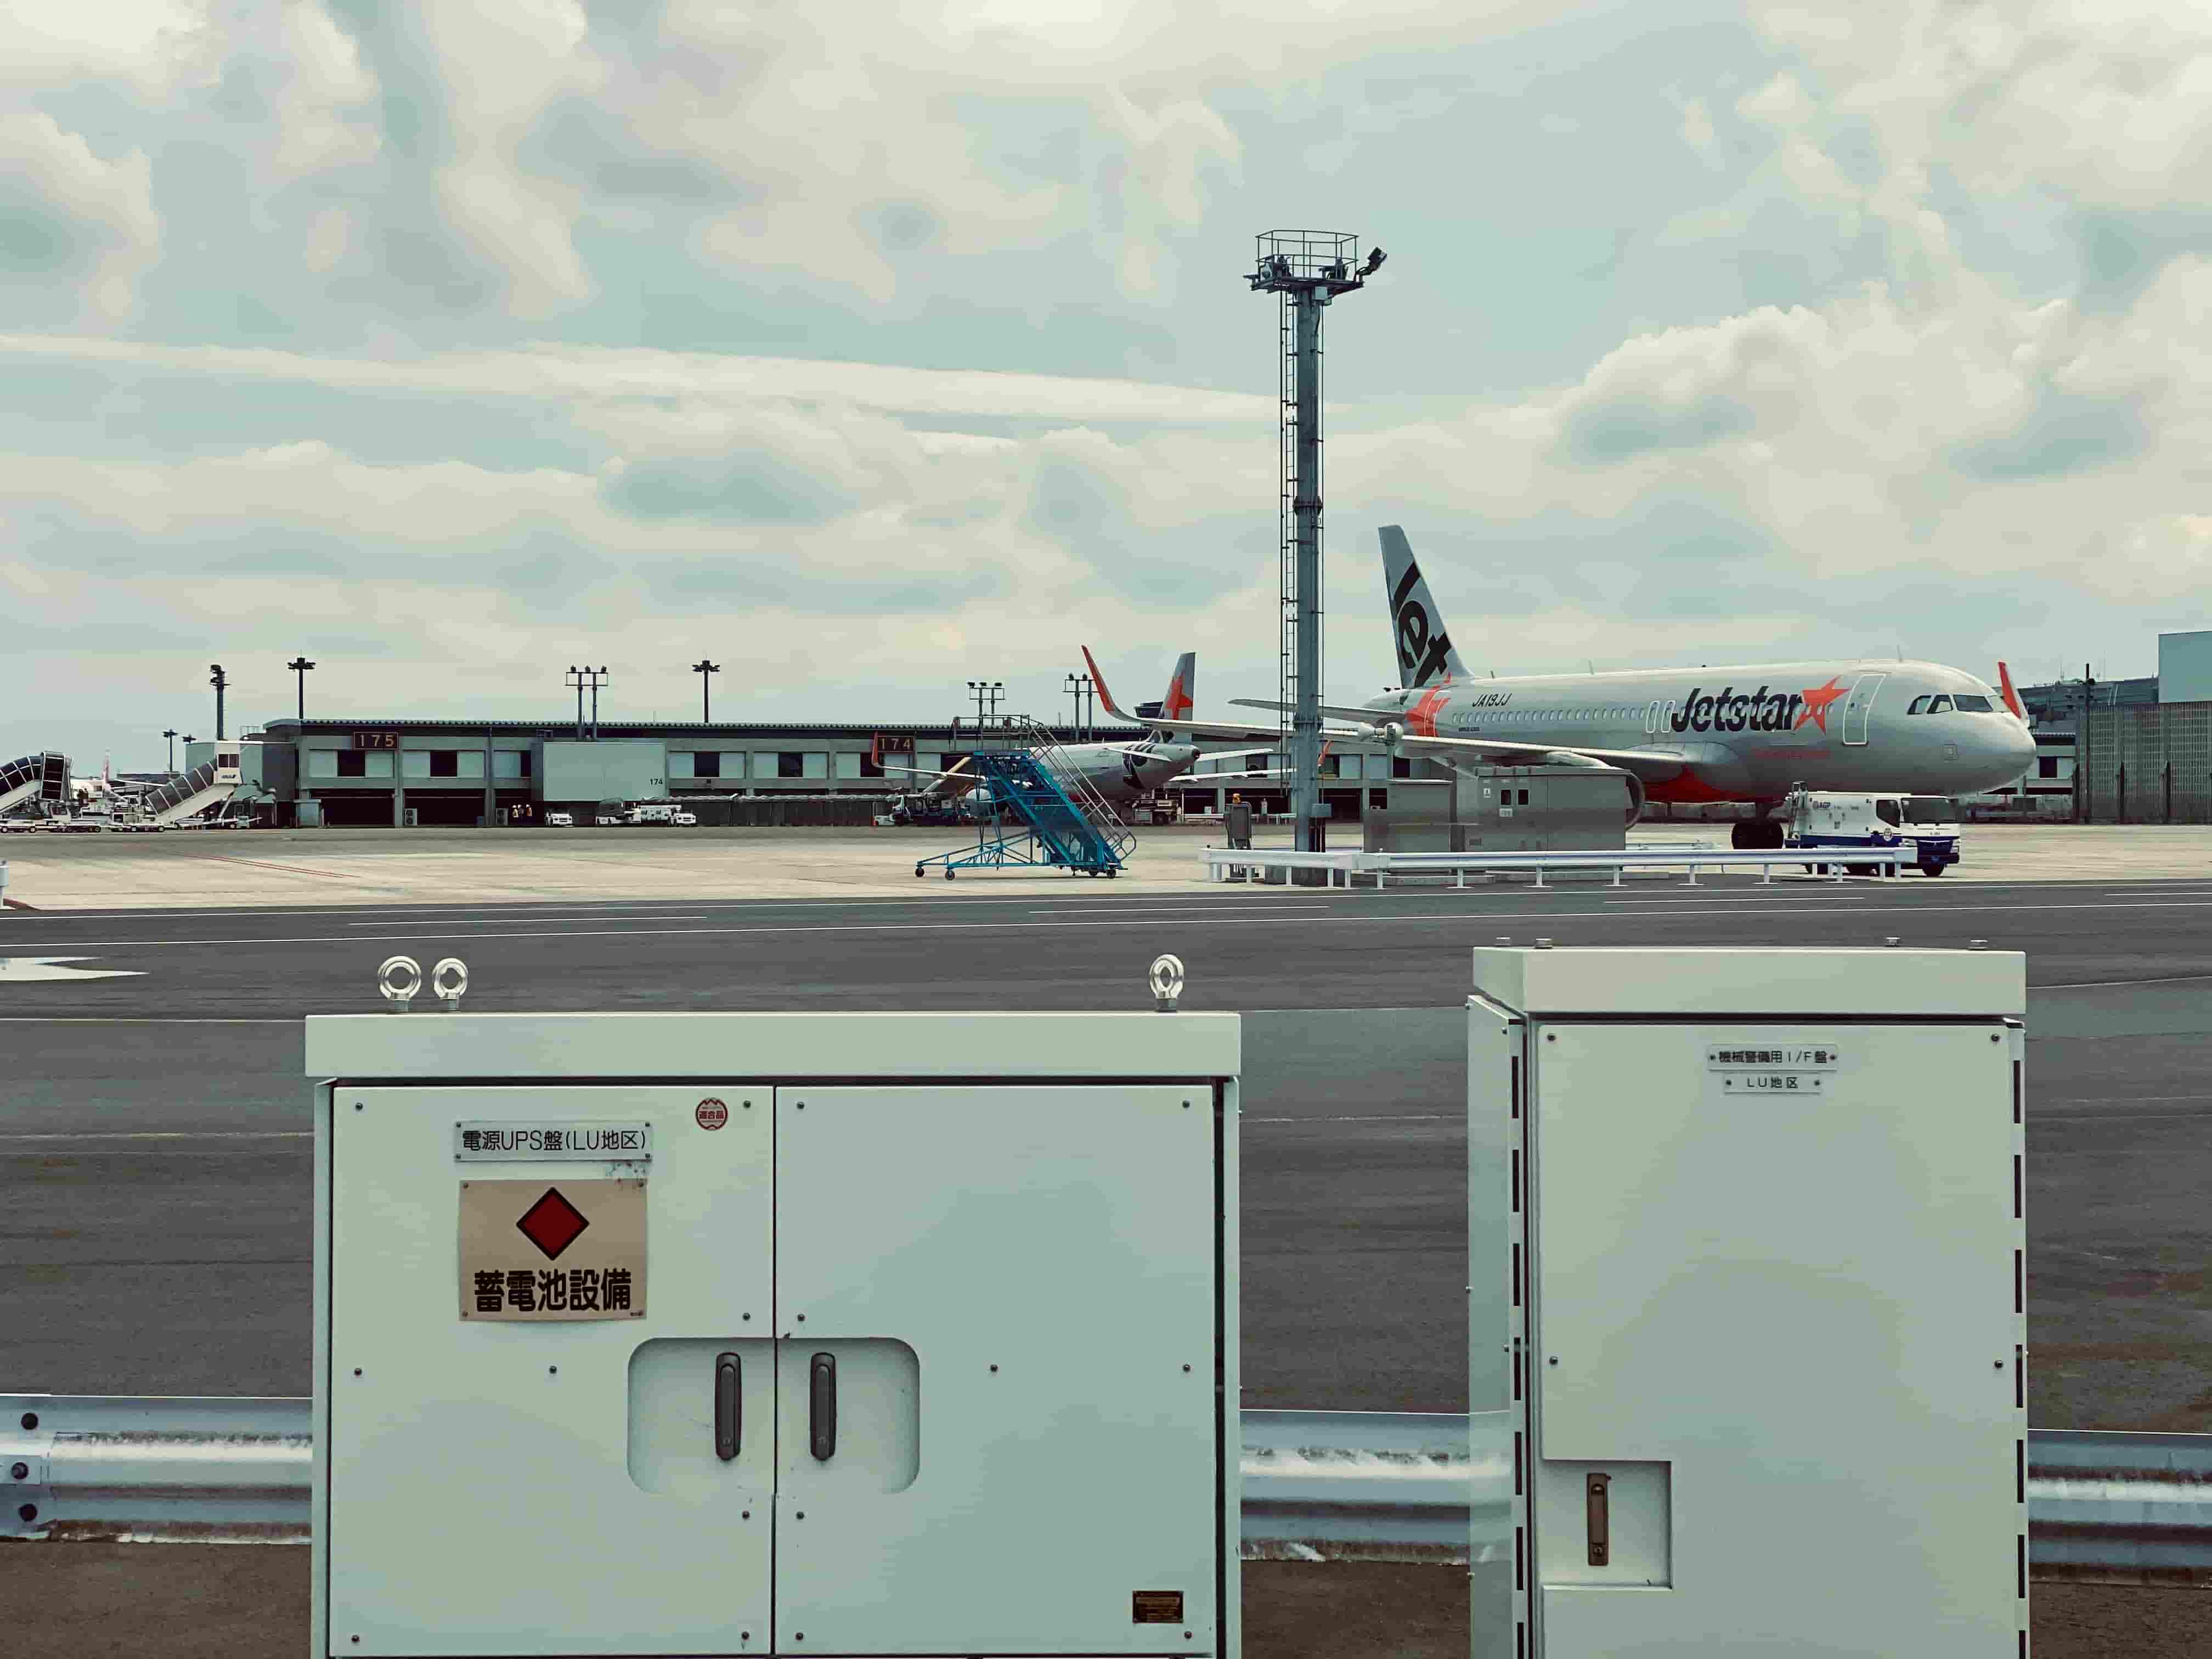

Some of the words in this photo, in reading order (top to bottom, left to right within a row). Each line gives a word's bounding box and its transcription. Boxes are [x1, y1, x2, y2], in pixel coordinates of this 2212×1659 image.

[1472, 693, 1513, 707] JA19JJ
[1671, 686, 1803, 732] Jetstar
[360, 735, 394, 747] 175
[882, 738, 910, 750] 174
[1747, 1076, 1798, 1088] LU地区
[462, 1130, 645, 1151] 電源UPS盤(LU地区)
[474, 1268, 631, 1312] 蓄電池設備
